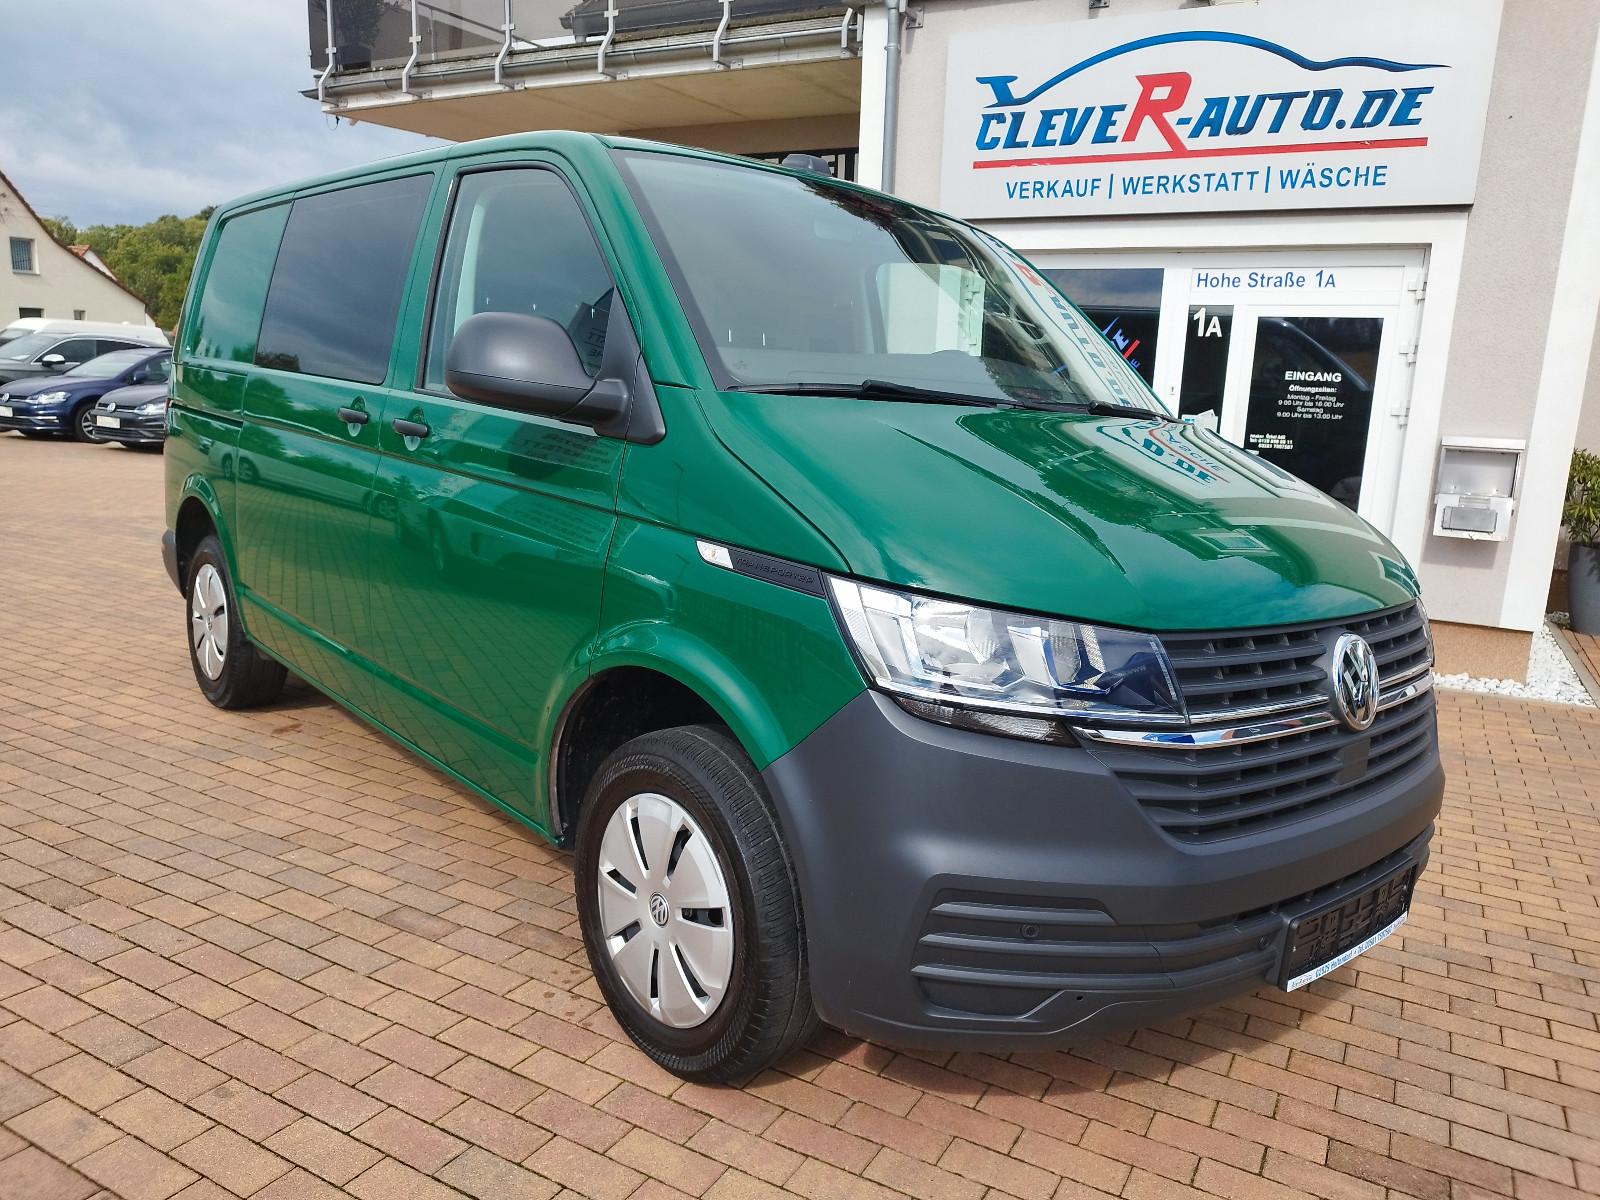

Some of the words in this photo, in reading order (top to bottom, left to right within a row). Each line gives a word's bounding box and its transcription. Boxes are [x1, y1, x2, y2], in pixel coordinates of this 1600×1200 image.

[975, 71, 1434, 152] CLEVER-AUTO.DE
[1006, 178, 1102, 200] VERKAUF
[1122, 170, 1260, 196] WERKSTATT
[1279, 163, 1388, 190] WÄSCHE
[1196, 272, 1241, 288] Hohe
[1247, 271, 1306, 288] Straße
[1315, 269, 1336, 288] 1A
[1193, 307, 1223, 338] 1A
[1284, 370, 1342, 383] EINGANG
[1315, 394, 1337, 402] Freitag
[1296, 406, 1324, 414] Samstag
